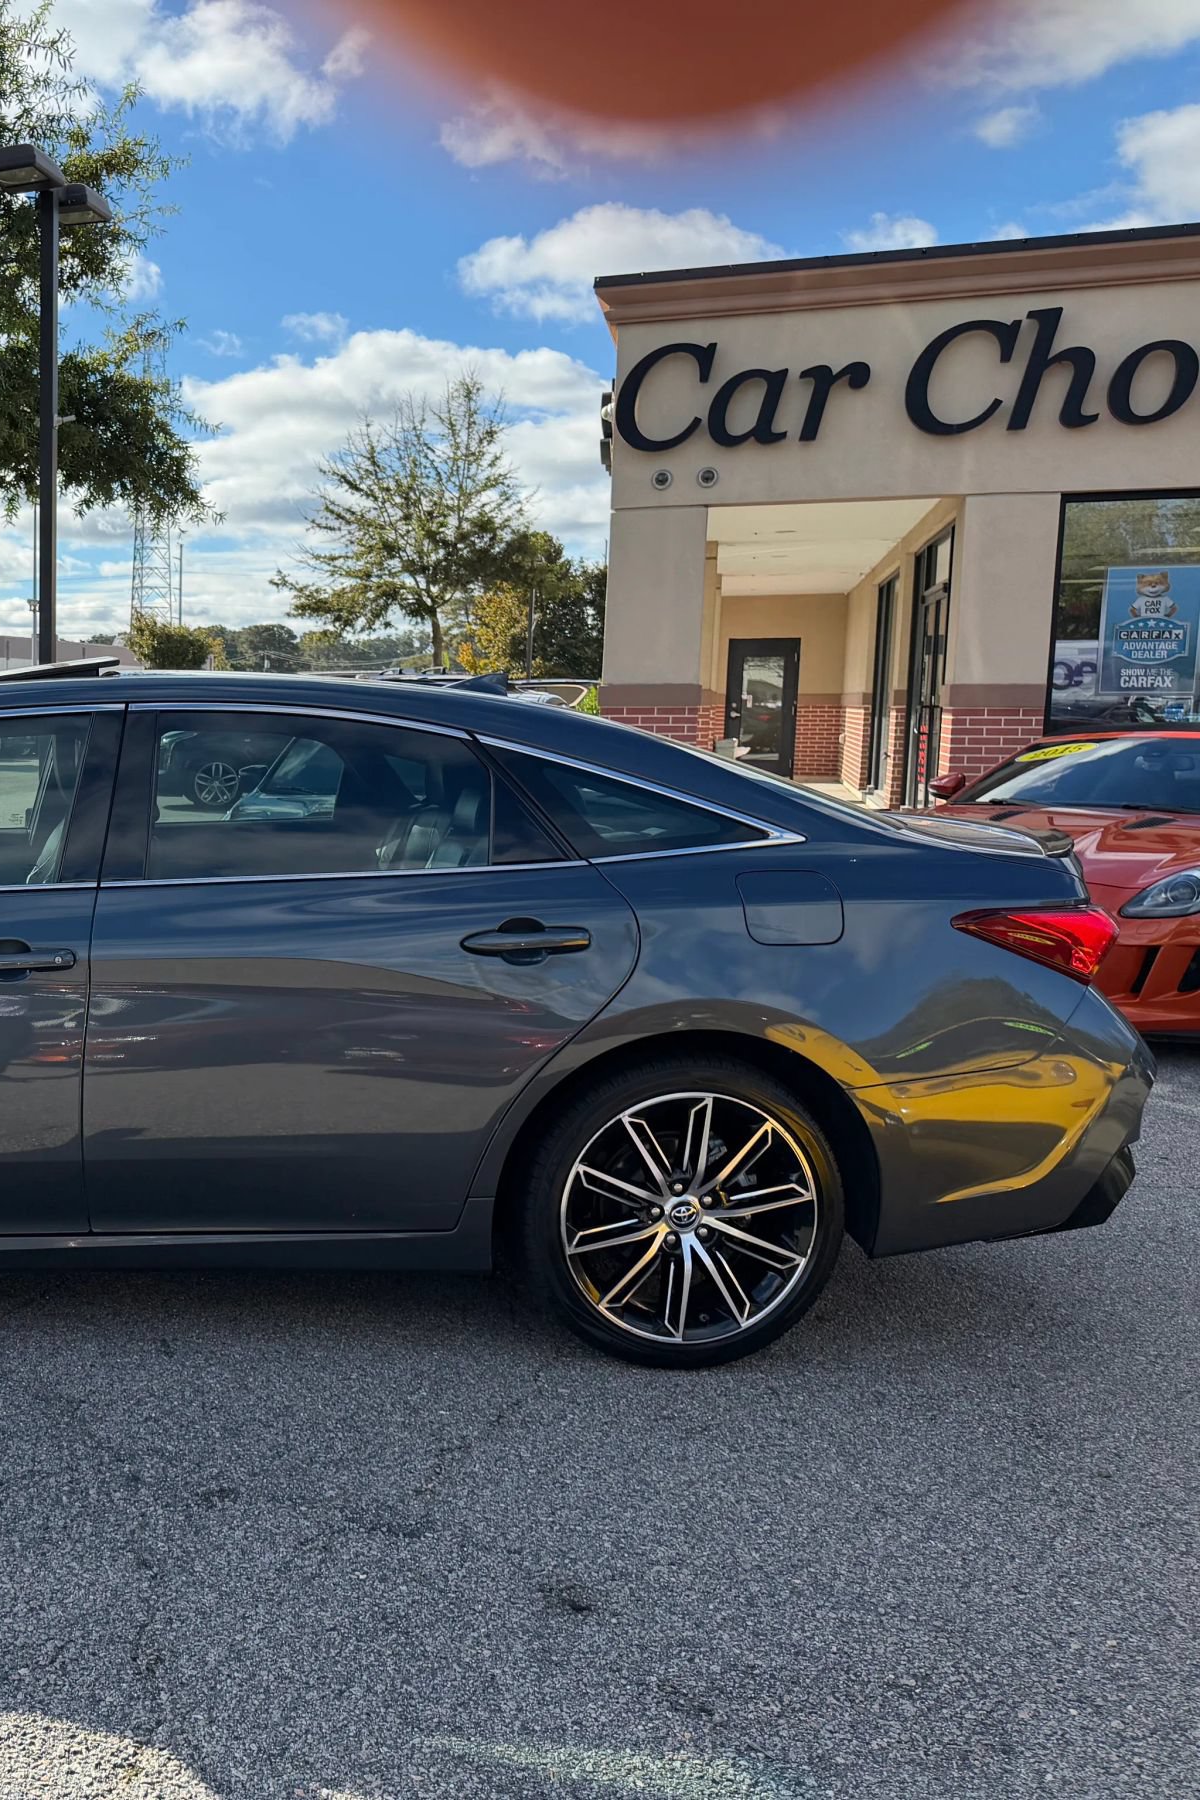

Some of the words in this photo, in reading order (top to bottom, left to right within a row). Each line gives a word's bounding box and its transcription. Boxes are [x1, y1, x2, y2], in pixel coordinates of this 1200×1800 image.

[616, 342, 871, 452] Car
[905, 307, 1200, 436] Cho
[1144, 600, 1162, 608] CAR
[1120, 630, 1183, 640] CARFAX
[1122, 641, 1179, 650] ADVANTAGE
[1131, 650, 1168, 659] DEALER
[1120, 668, 1146, 676] SHOW
[1146, 668, 1159, 676] ME
[1160, 668, 1175, 676] THE
[1120, 676, 1173, 688] CARFAX
